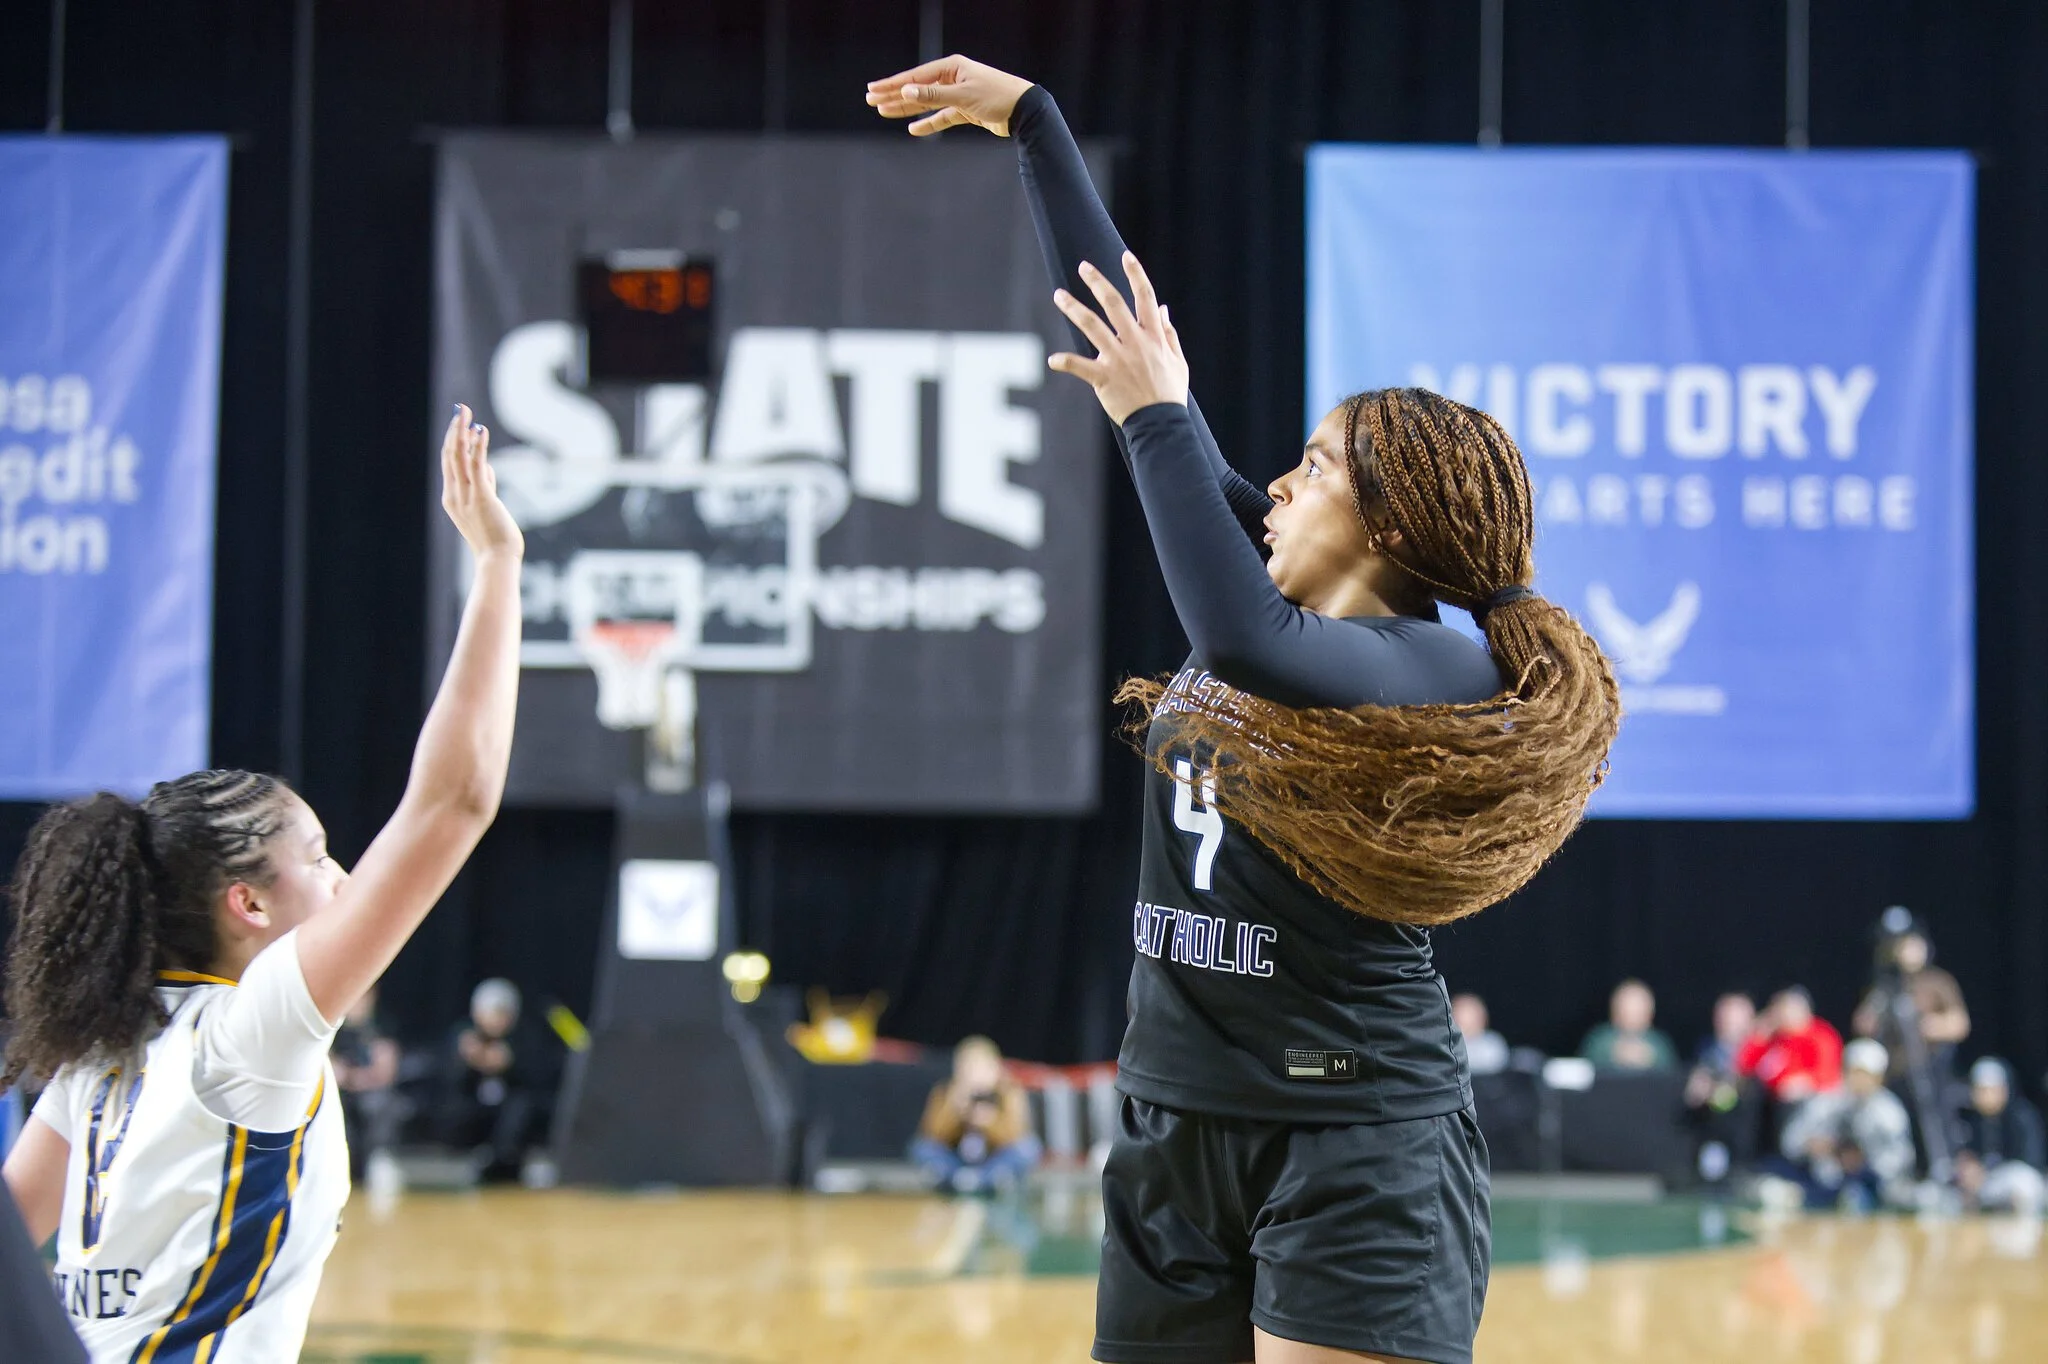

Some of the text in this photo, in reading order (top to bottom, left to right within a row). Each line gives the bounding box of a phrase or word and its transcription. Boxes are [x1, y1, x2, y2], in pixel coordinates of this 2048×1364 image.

[0, 375, 91, 433] sa
[490, 321, 1046, 552] SATE
[1740, 475, 1917, 531] HERE
[1171, 753, 1225, 895] 4
[1133, 900, 1278, 978] CATHOLIC
[1334, 1058, 1347, 1071] M
